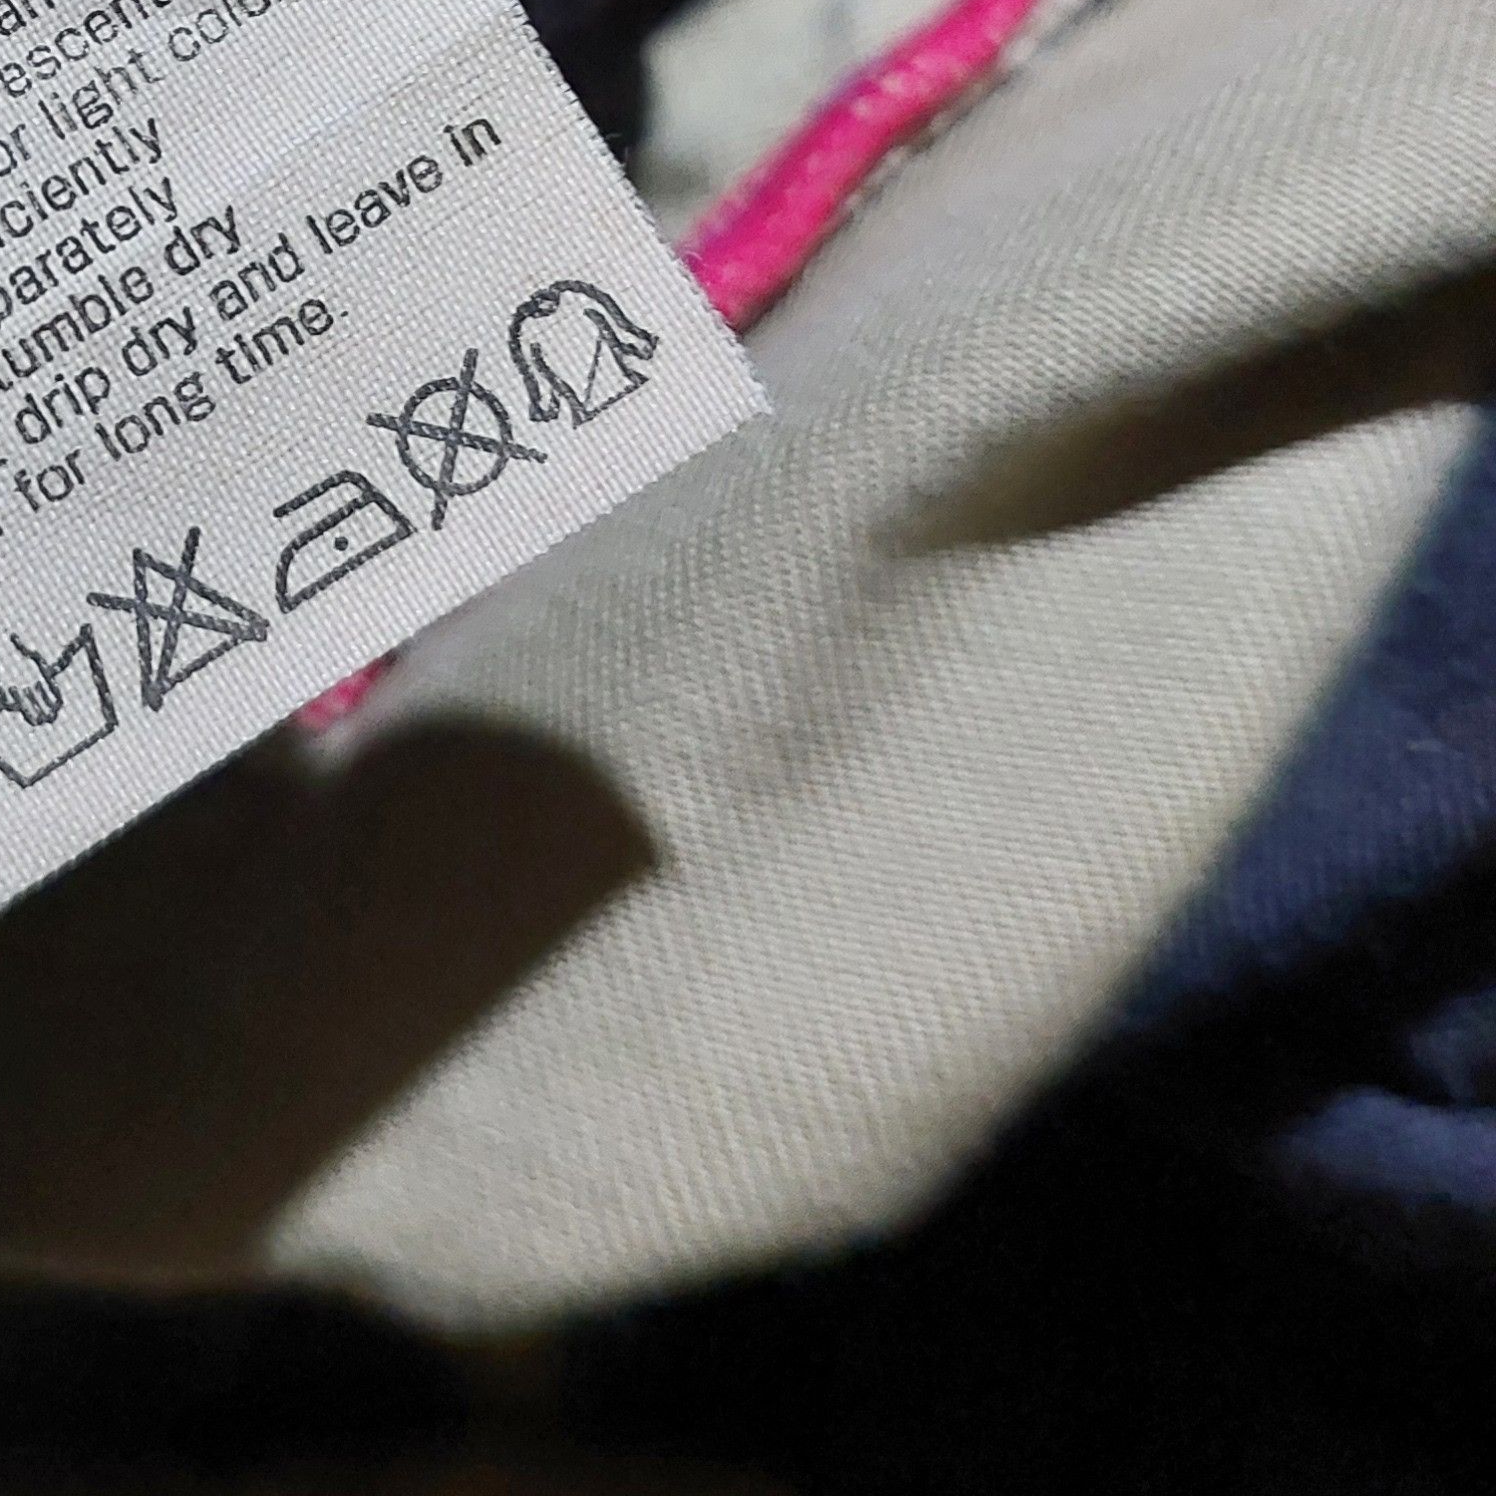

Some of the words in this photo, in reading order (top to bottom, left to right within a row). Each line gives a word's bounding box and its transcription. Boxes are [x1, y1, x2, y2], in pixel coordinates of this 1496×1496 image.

[39, 48, 165, 140] light
[15, 366, 110, 444] drip
[121, 306, 198, 376] dry
[208, 232, 303, 321] and
[306, 155, 443, 254] leave
[444, 117, 501, 167] in
[164, 205, 239, 276] dry
[14, 449, 85, 511] for
[96, 371, 215, 462] long
